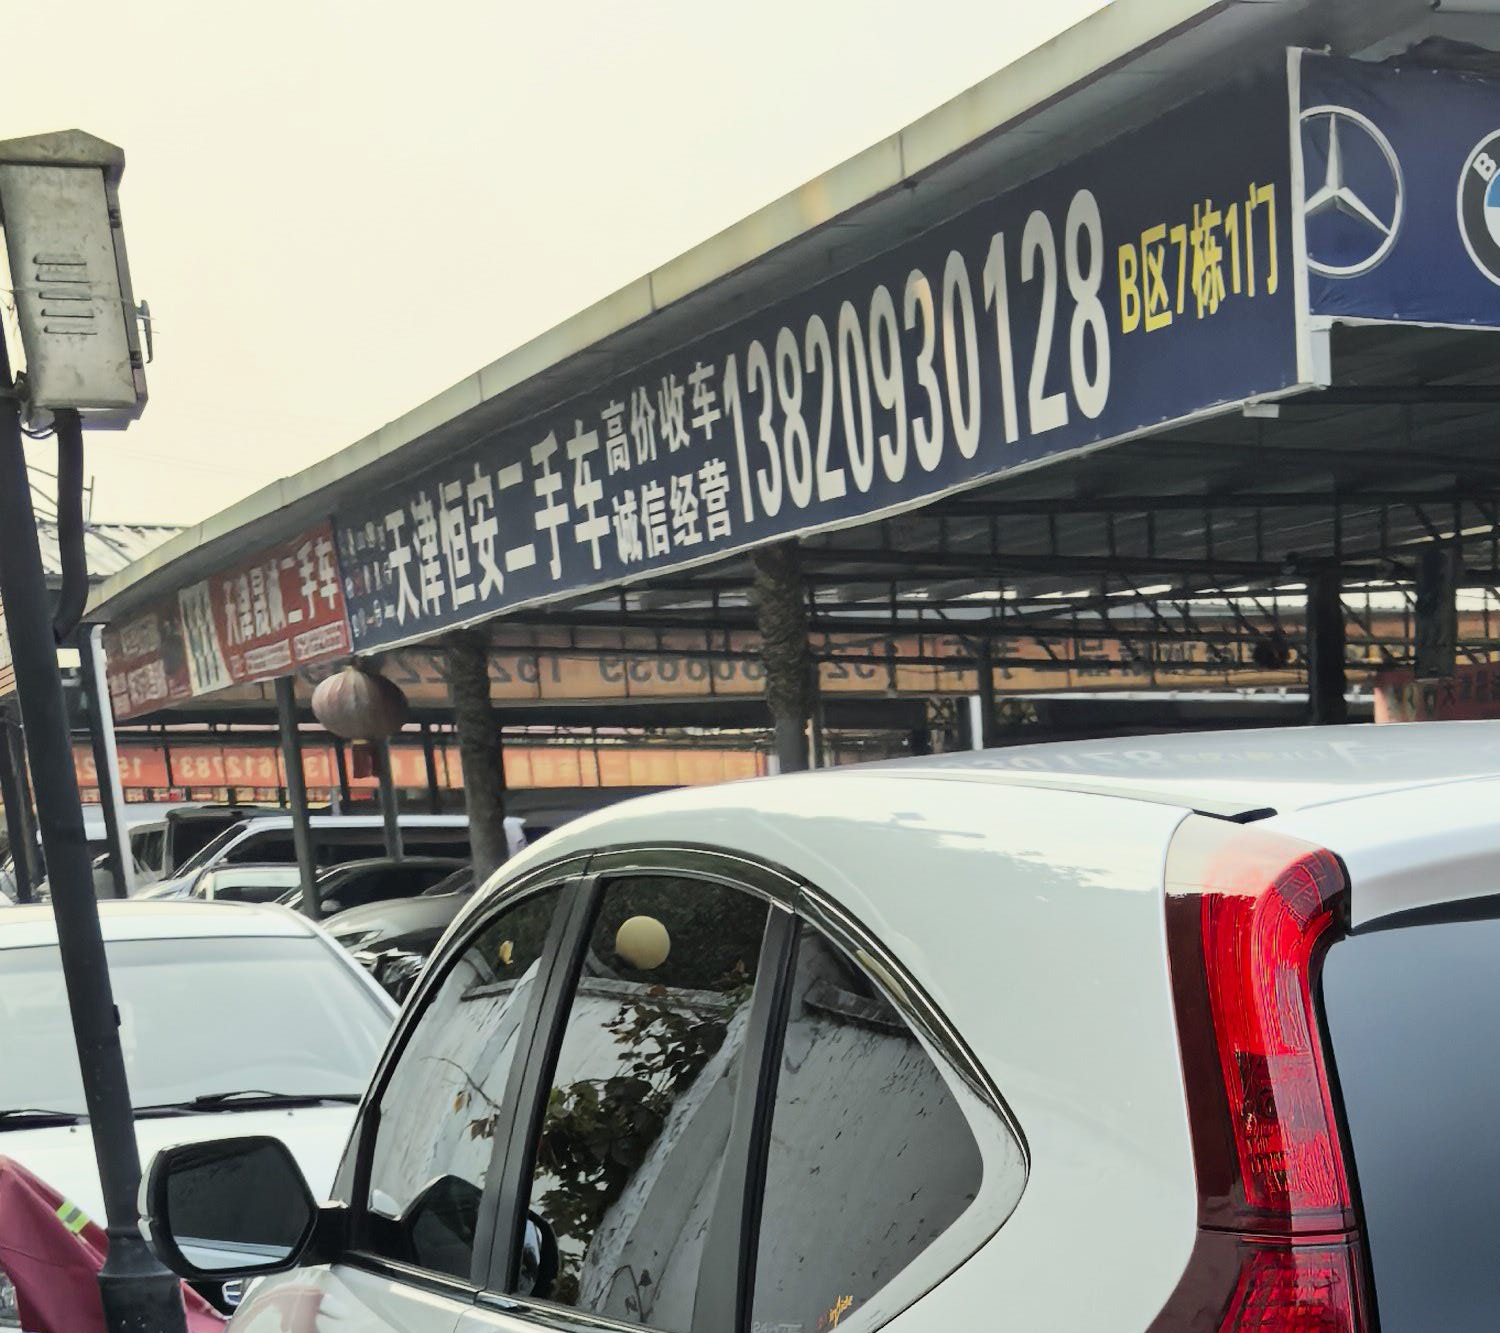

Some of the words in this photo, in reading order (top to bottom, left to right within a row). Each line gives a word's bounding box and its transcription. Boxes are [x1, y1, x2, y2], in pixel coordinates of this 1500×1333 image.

[1118, 181, 1279, 335] B区7栋1门
[601, 361, 721, 476] 高价收车
[722, 188, 1112, 525] 13820930128
[385, 418, 611, 627] 天津恒安二手车
[612, 457, 732, 566] 诚信经营
